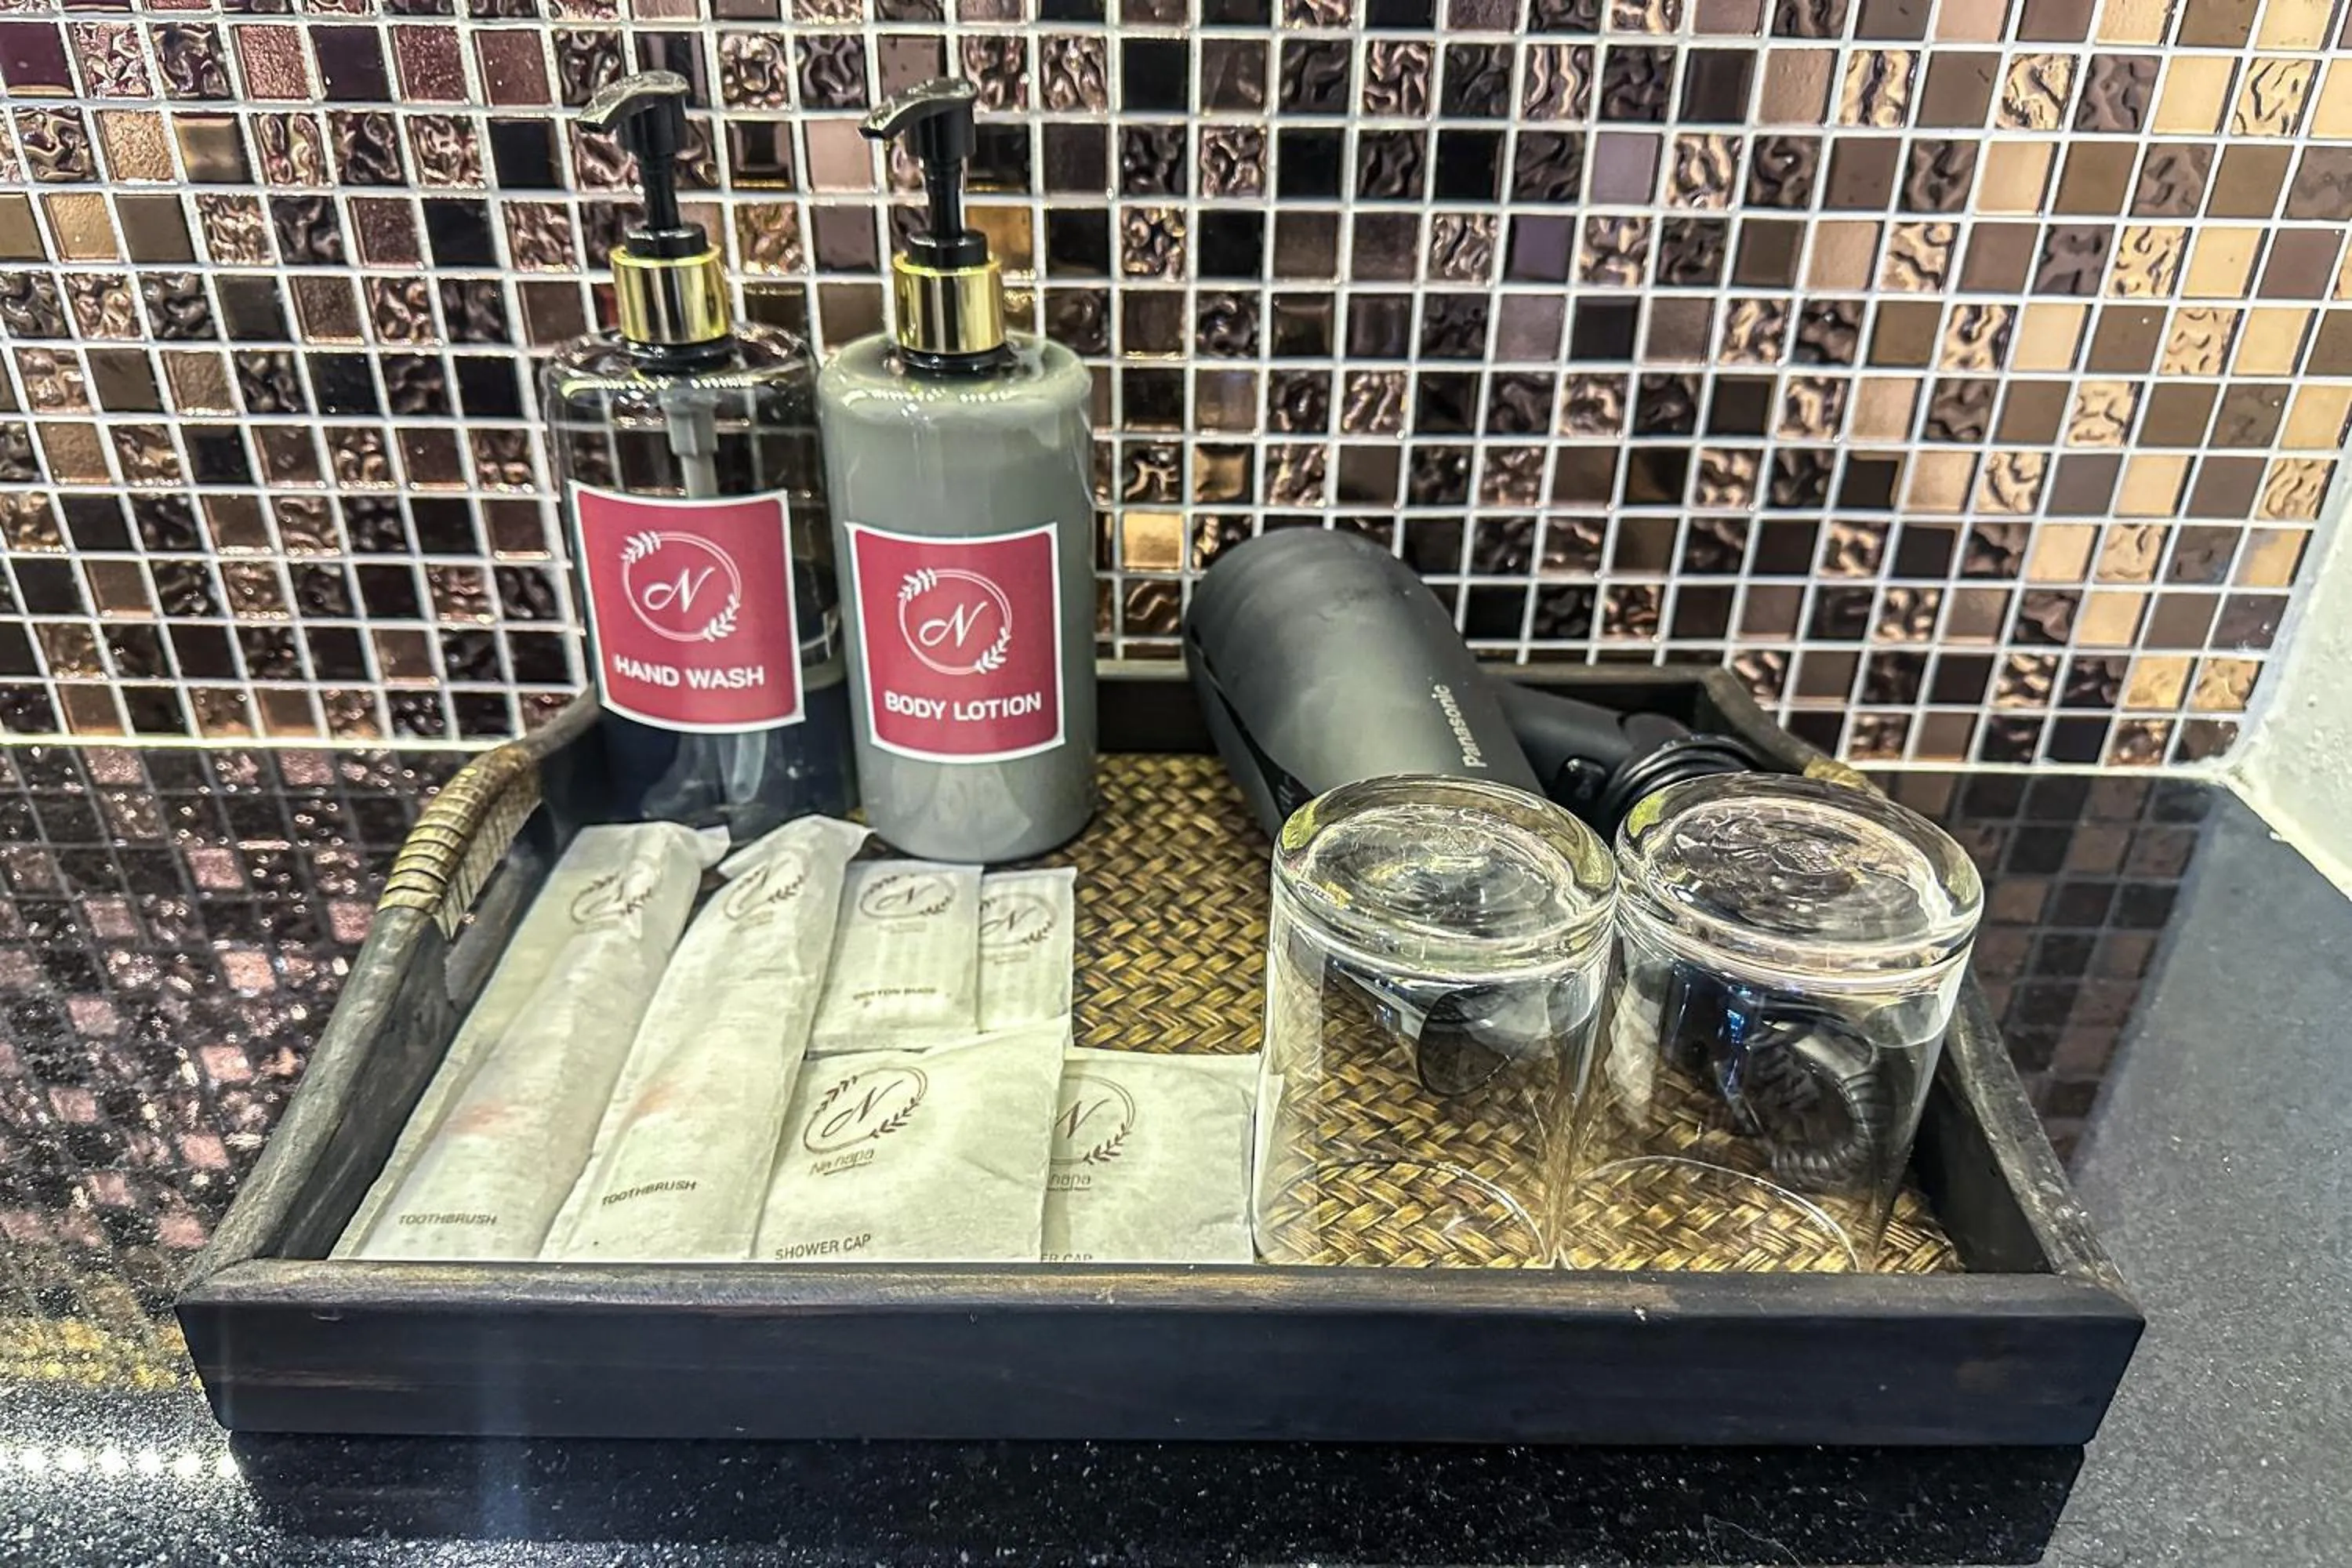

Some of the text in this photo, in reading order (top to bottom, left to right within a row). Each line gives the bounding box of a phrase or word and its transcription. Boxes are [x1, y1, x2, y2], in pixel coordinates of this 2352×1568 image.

[613, 654, 765, 690] HAND WASH
[884, 691, 1042, 722] BODY LOTION
[1431, 684, 1488, 768] Panasonic
[601, 1181, 697, 1205] TOOTHBRUSH
[398, 1213, 498, 1225] TOOTHBRUSH
[775, 1232, 872, 1261] SHOWER CAP
